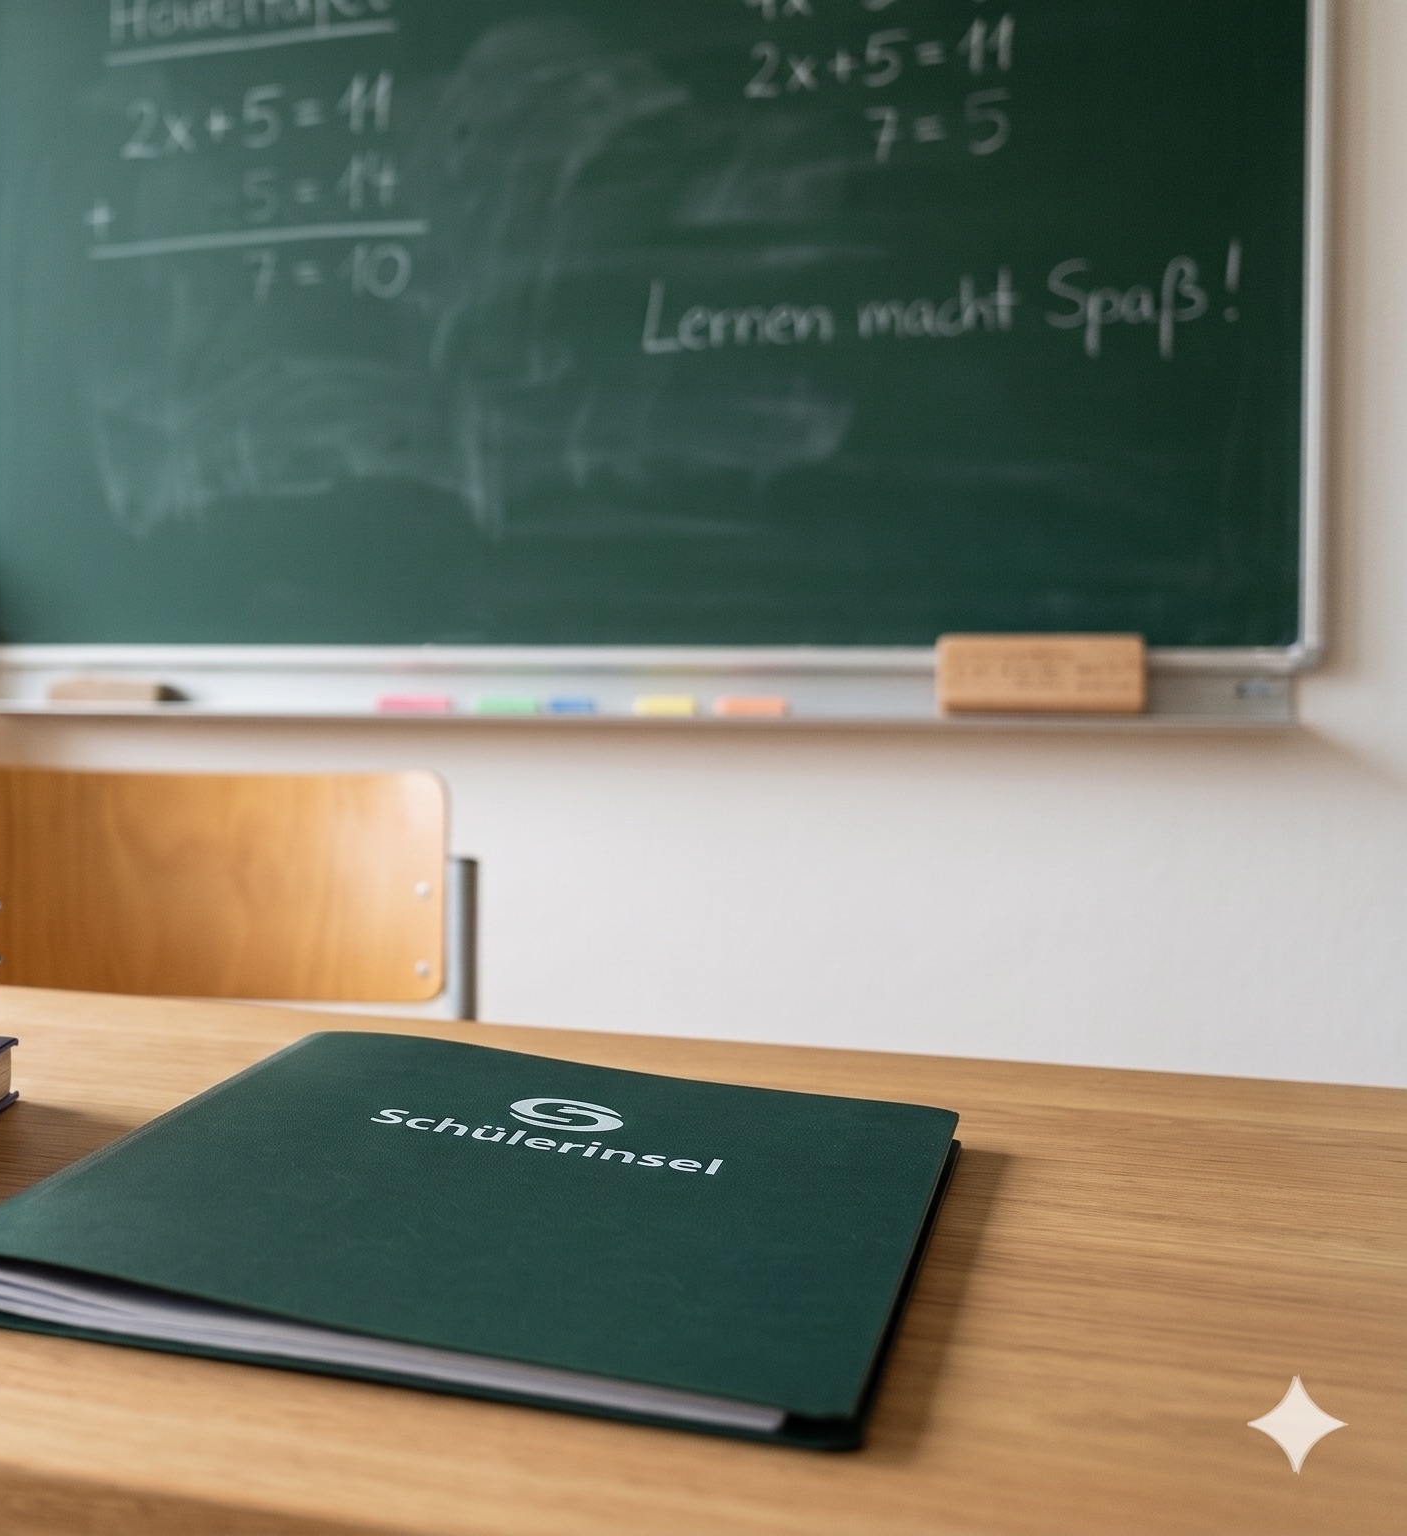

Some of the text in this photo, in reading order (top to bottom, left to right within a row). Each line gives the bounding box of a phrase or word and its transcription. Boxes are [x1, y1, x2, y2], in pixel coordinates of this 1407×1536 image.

[640, 278, 835, 355] Lernen
[856, 265, 1017, 342] macht
[370, 1107, 724, 1176] Schülerinsel
